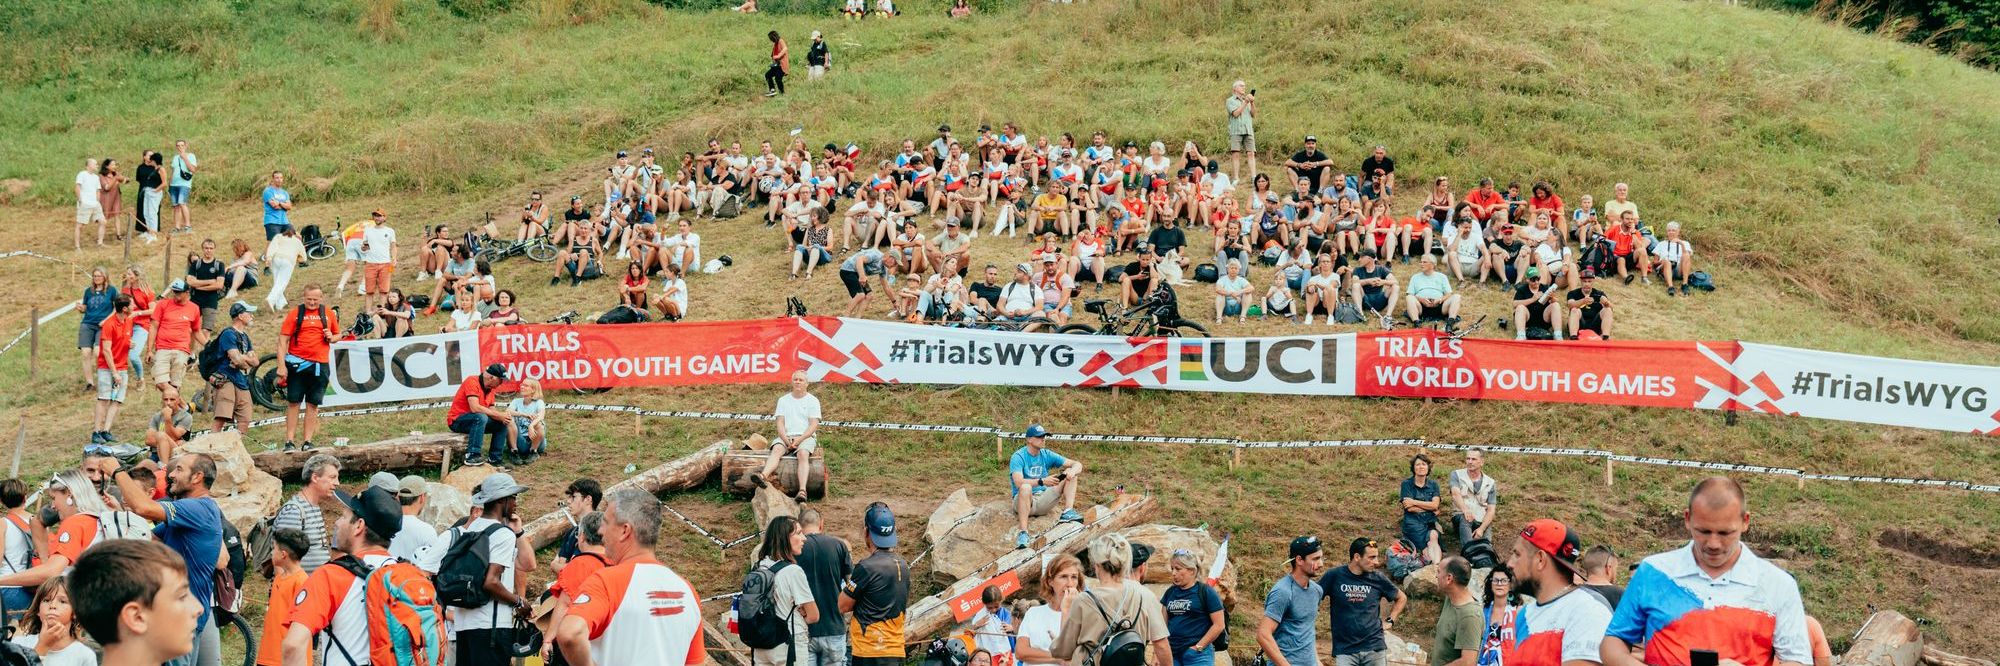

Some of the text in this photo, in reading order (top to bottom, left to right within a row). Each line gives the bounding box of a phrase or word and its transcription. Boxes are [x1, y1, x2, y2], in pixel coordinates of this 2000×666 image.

[496, 332, 580, 354] TRIALS
[889, 339, 1074, 367] #TrialsWYG
[1375, 337, 1464, 360] TRIALS
[334, 340, 462, 394] UCI
[501, 353, 780, 382] WORLD YOUTH GAMES
[1210, 338, 1337, 384] UCI
[1375, 366, 1676, 396] WORLD YOUTH GAMES
[1792, 372, 1988, 412] #TrialsWYG
[1340, 584, 1372, 594] OXBOW
[1168, 600, 1192, 610] FRANCE
